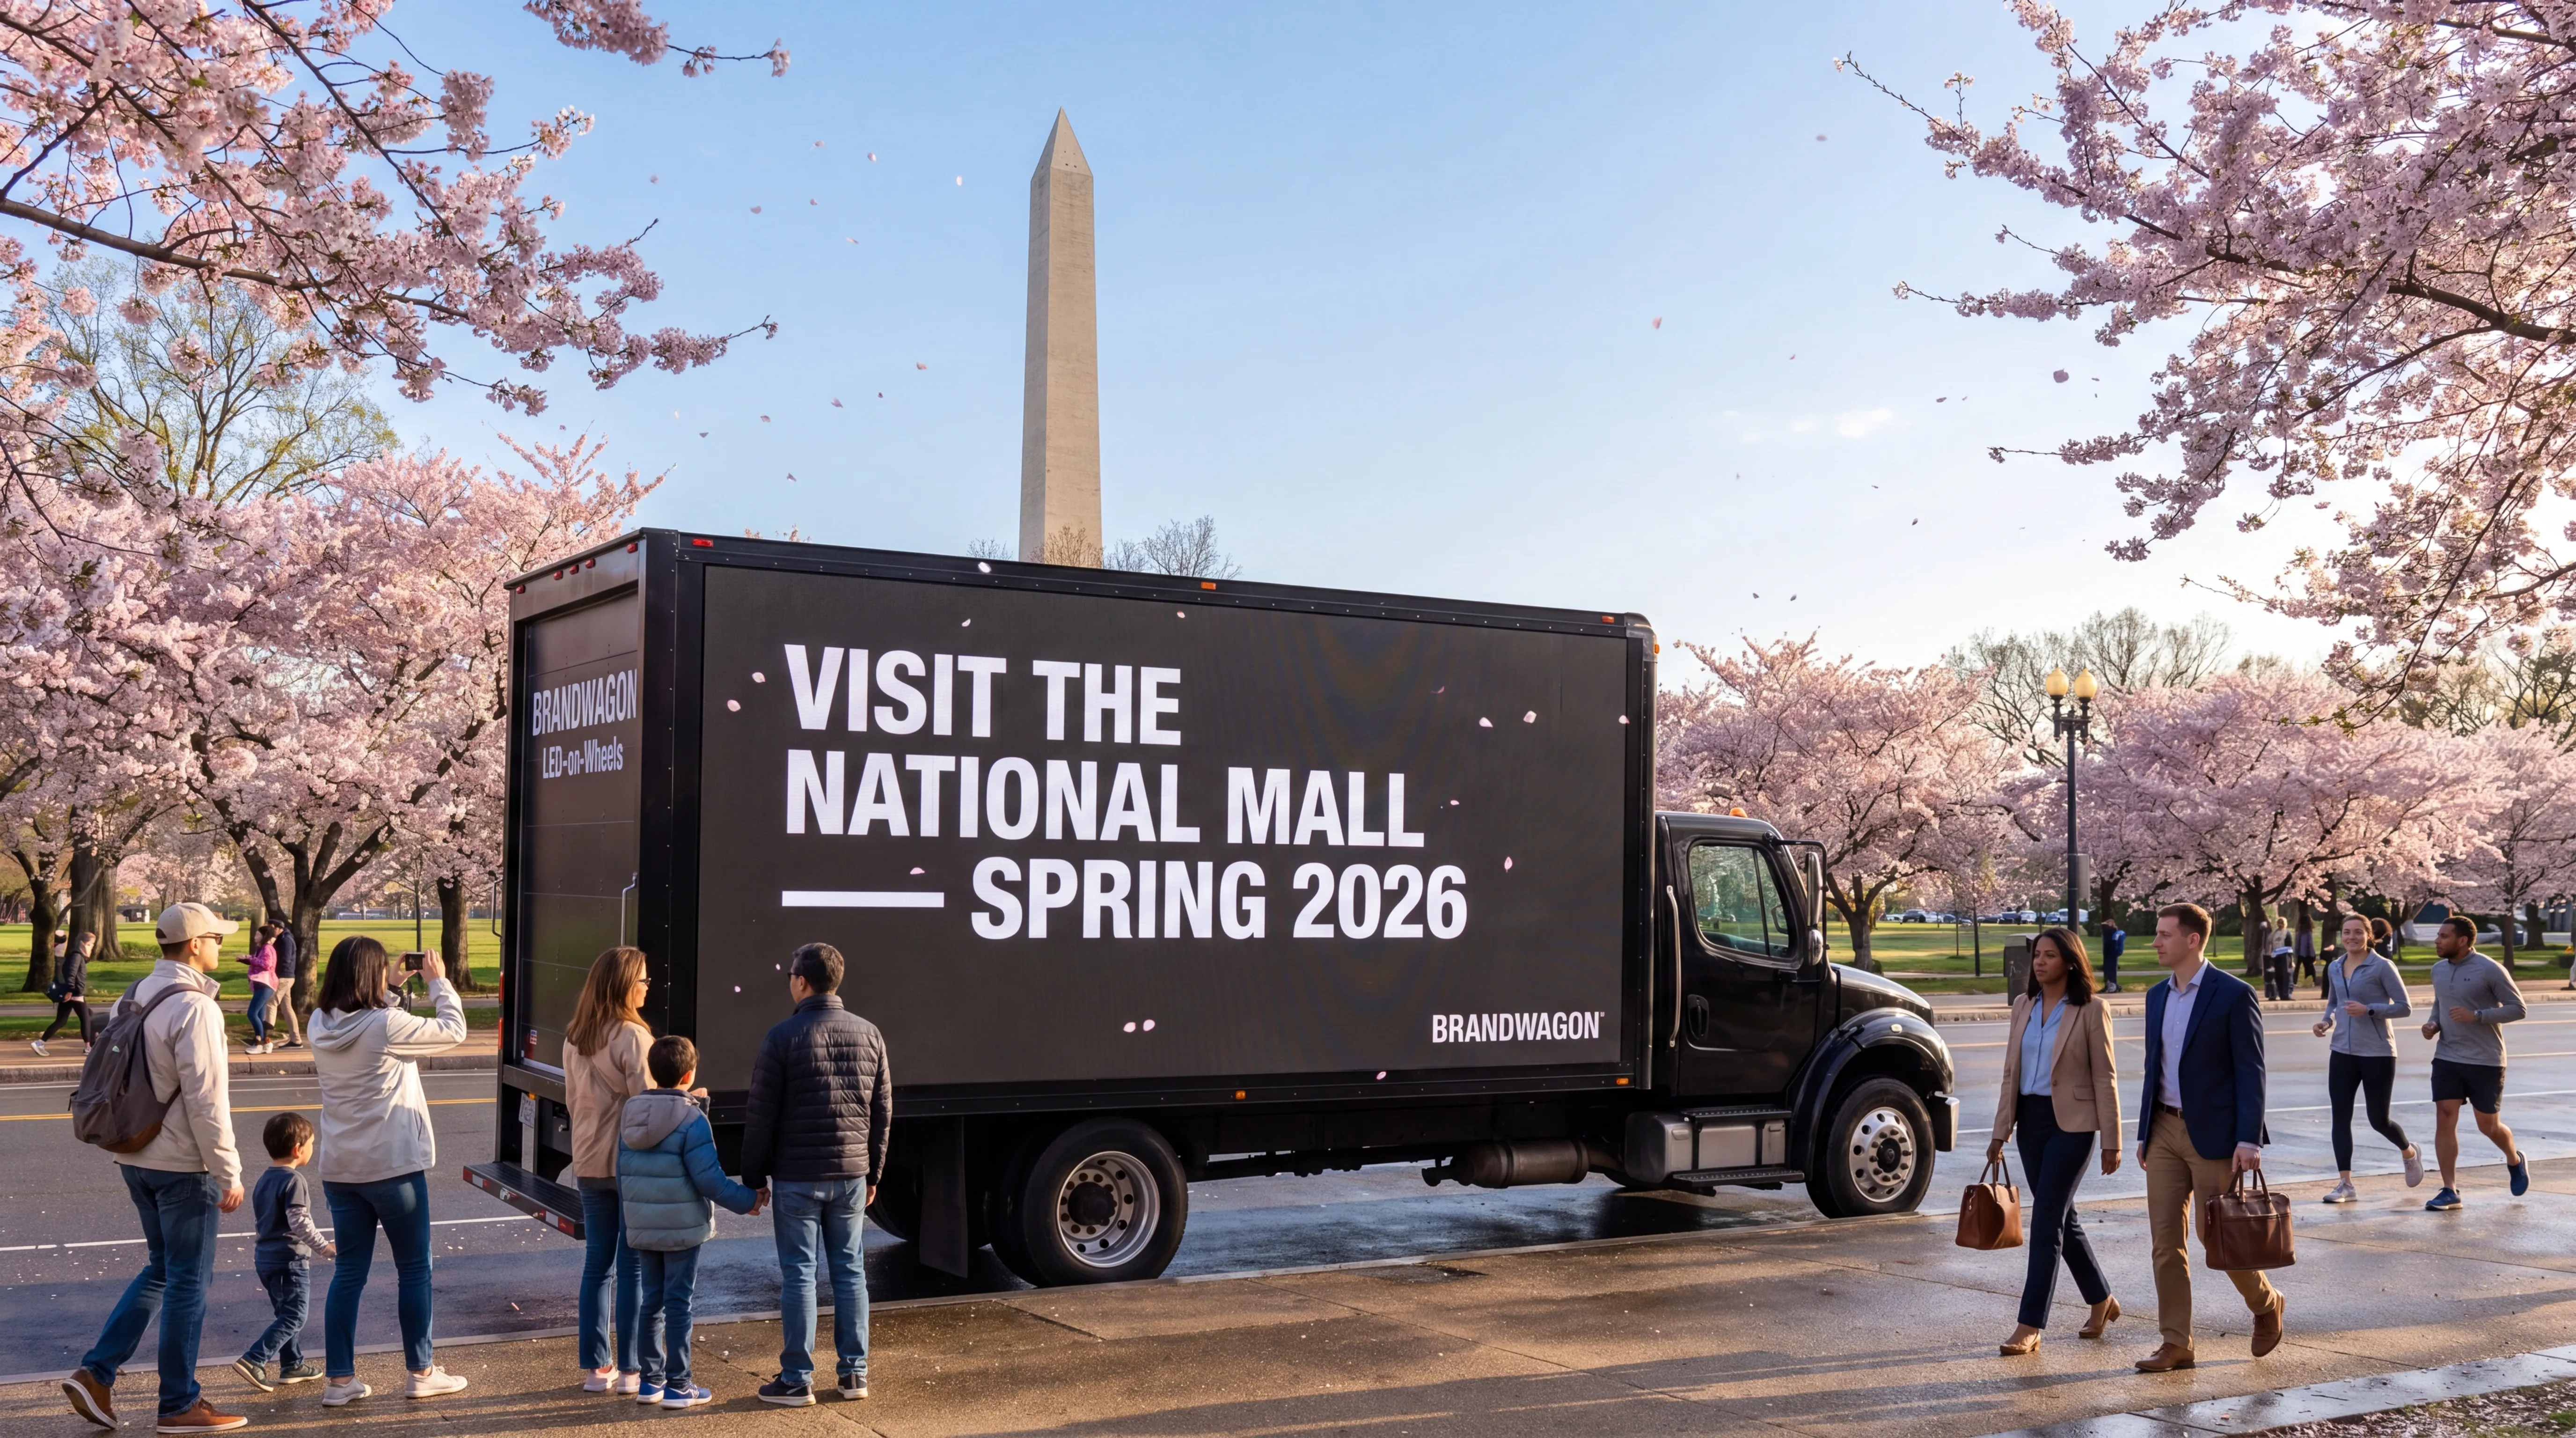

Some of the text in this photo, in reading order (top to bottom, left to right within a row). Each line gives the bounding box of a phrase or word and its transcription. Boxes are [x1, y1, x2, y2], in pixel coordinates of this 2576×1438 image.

[532, 668, 637, 736] BRANDWAGON
[784, 644, 1181, 746] VISIT THE
[542, 735, 624, 779] LED-on-Wheels
[787, 749, 1424, 848] NATIONAL MALL
[971, 856, 1266, 941] SPRING
[1293, 862, 1468, 940] 2026
